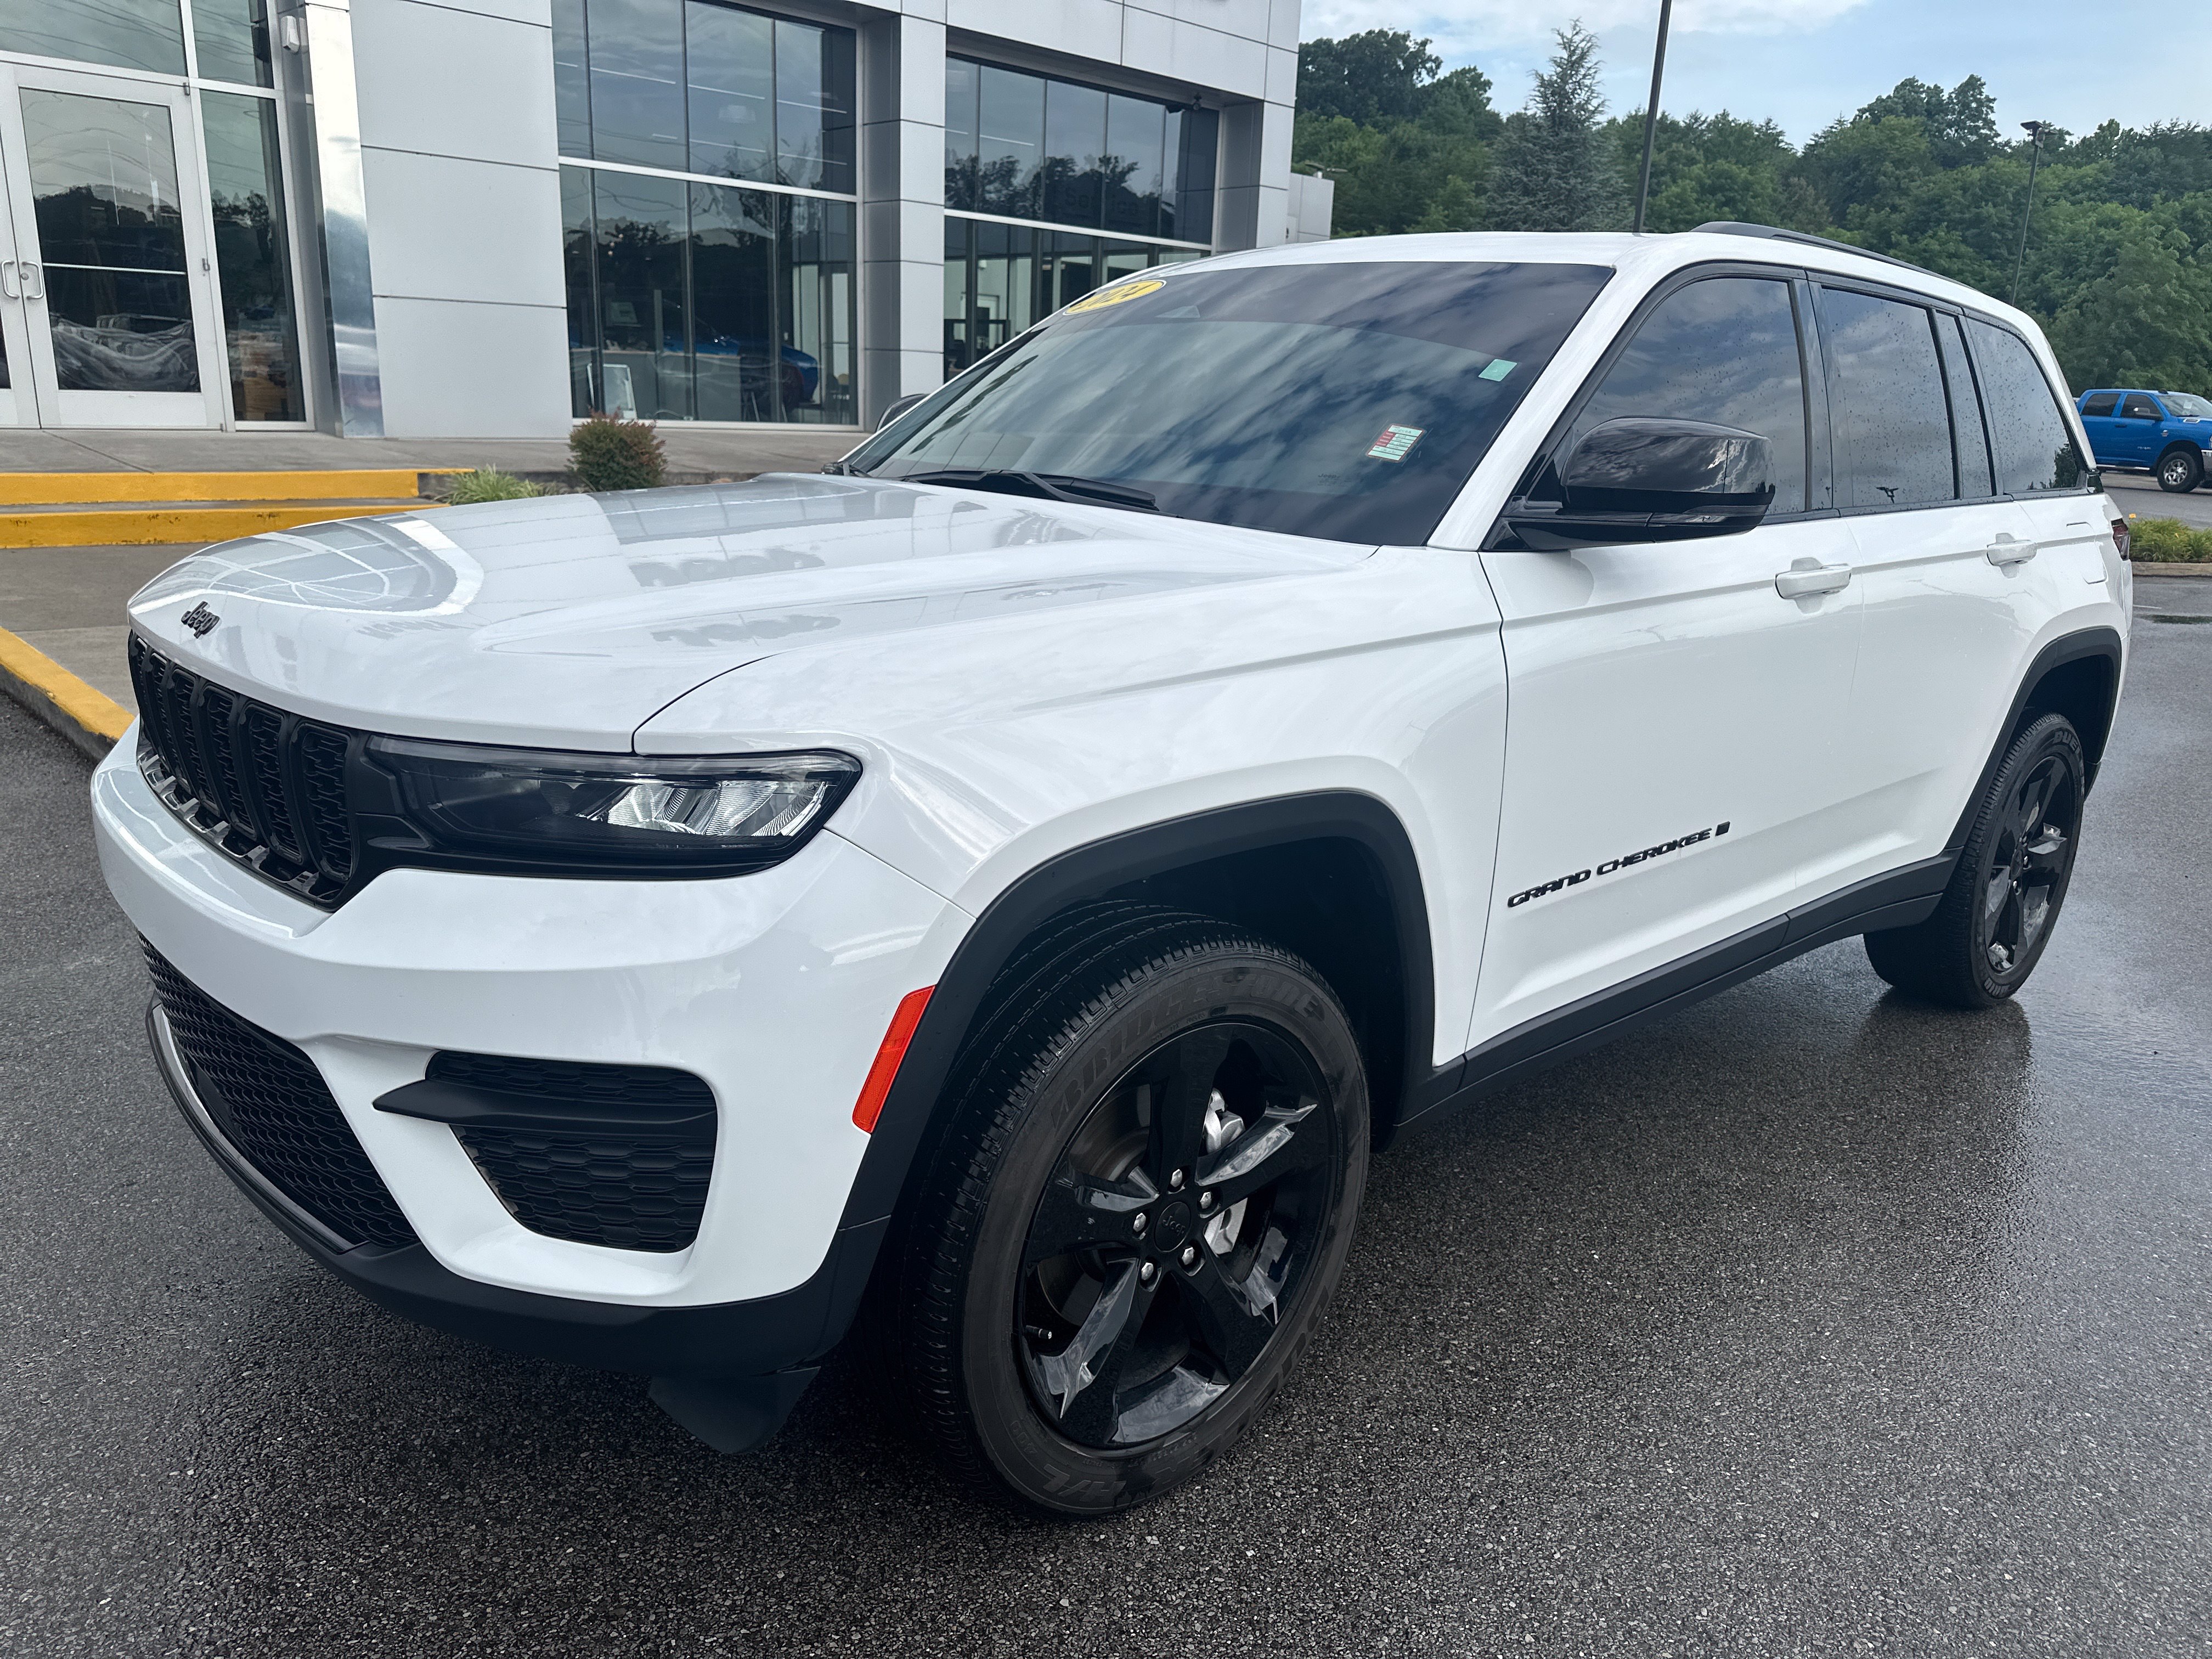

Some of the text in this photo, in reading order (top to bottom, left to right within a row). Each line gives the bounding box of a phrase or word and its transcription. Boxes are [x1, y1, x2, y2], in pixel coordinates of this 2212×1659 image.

[1064, 187, 1139, 217] Seice
[180, 601, 221, 639] Jeep
[1507, 827, 1712, 908] GRAND CHEROKEE
[1051, 971, 1322, 1135] BRIDGESTONE
[1162, 1215, 1186, 1237] Jeep
